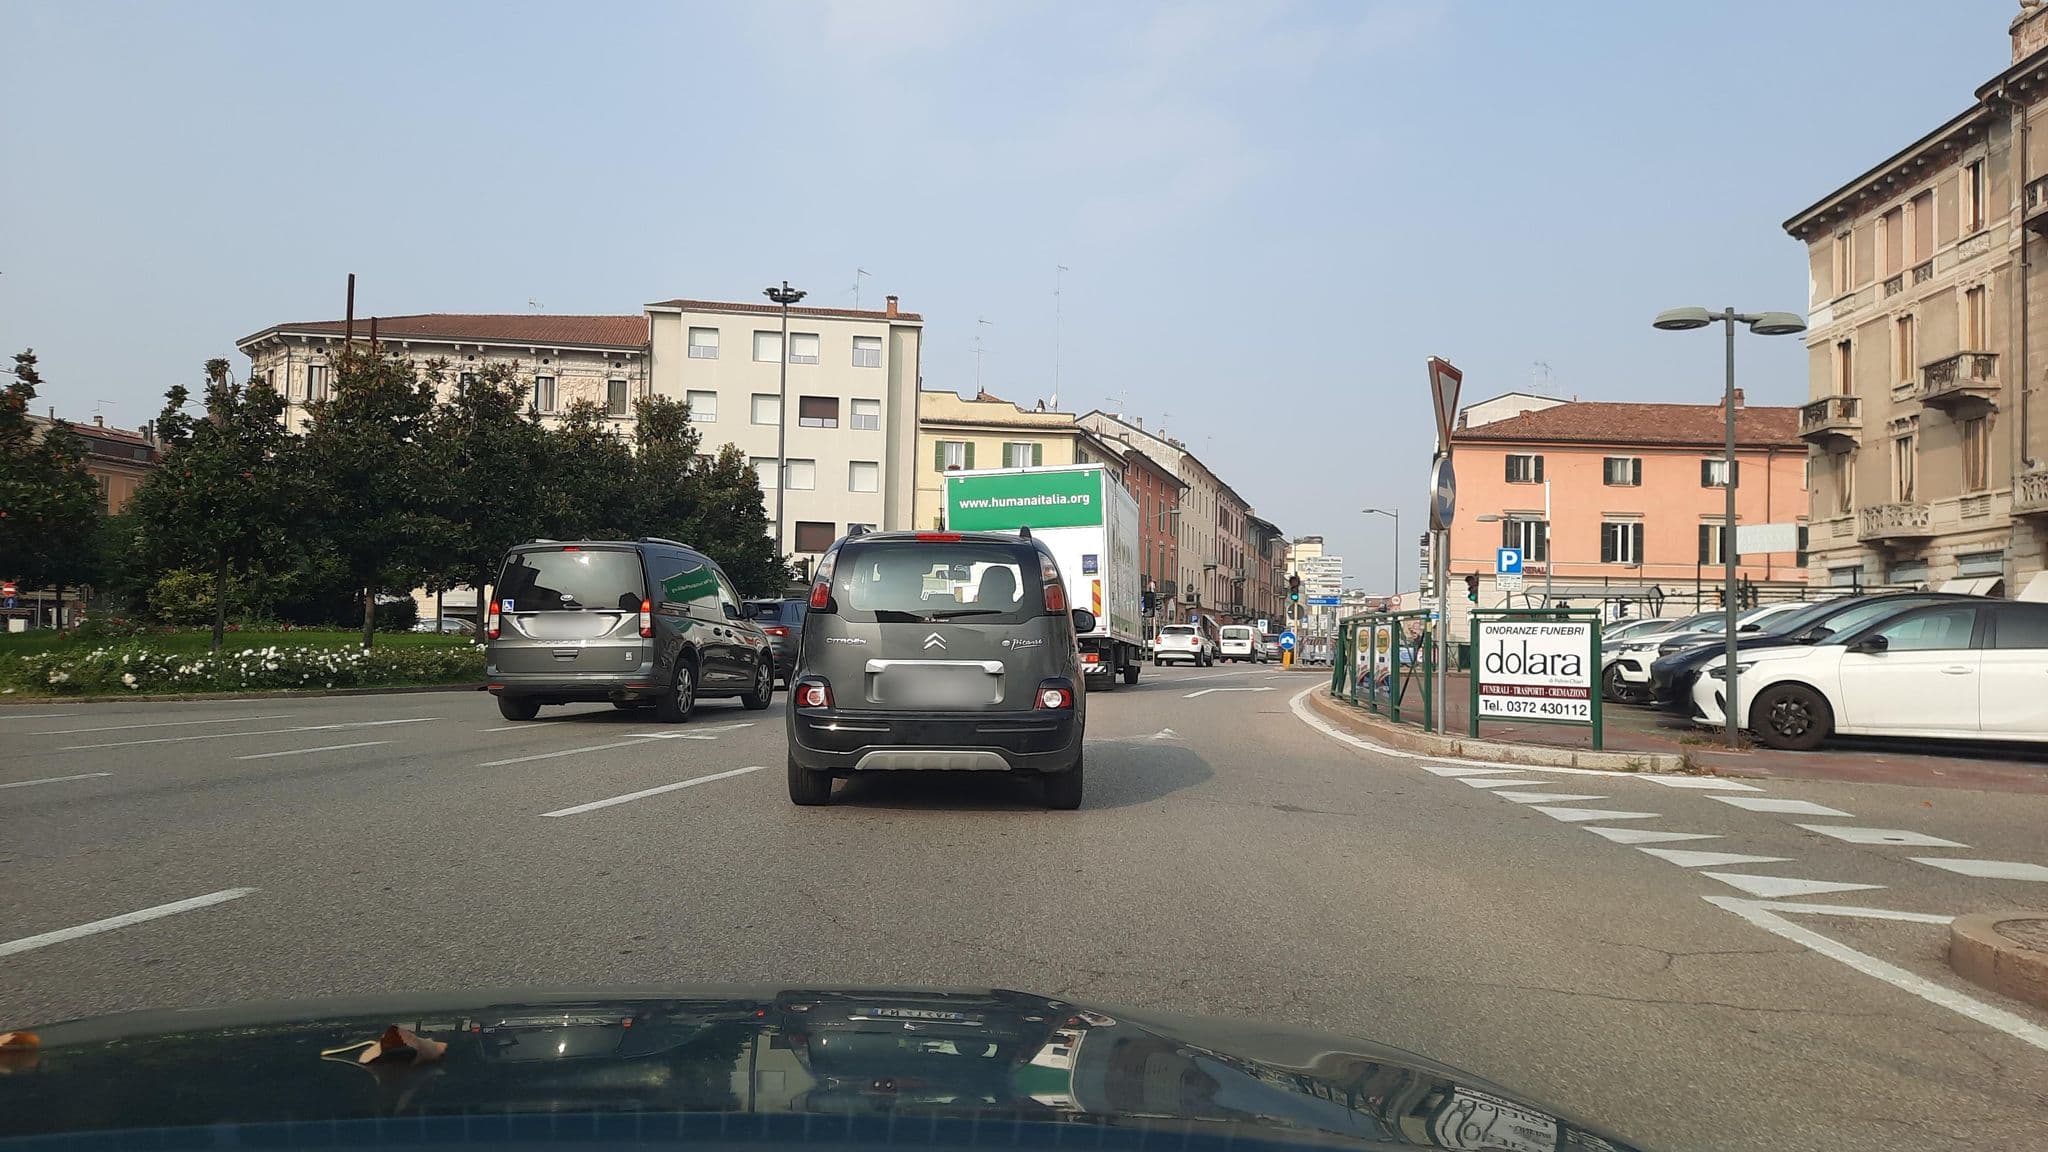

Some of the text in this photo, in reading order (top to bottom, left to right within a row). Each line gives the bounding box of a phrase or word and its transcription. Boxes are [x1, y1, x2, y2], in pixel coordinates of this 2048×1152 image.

[959, 494, 1090, 509] www.humanaitalia.org
[1501, 550, 1519, 572] P
[1485, 626, 1585, 636] ONORANZE FUNEBRI
[1485, 639, 1582, 677] dolara
[1482, 685, 1510, 694] FUNERALI
[1513, 686, 1545, 696] TRASPORTI
[1548, 688, 1587, 698] CREMAZIONI
[1482, 699, 1588, 716] Tel. 0372 430112
